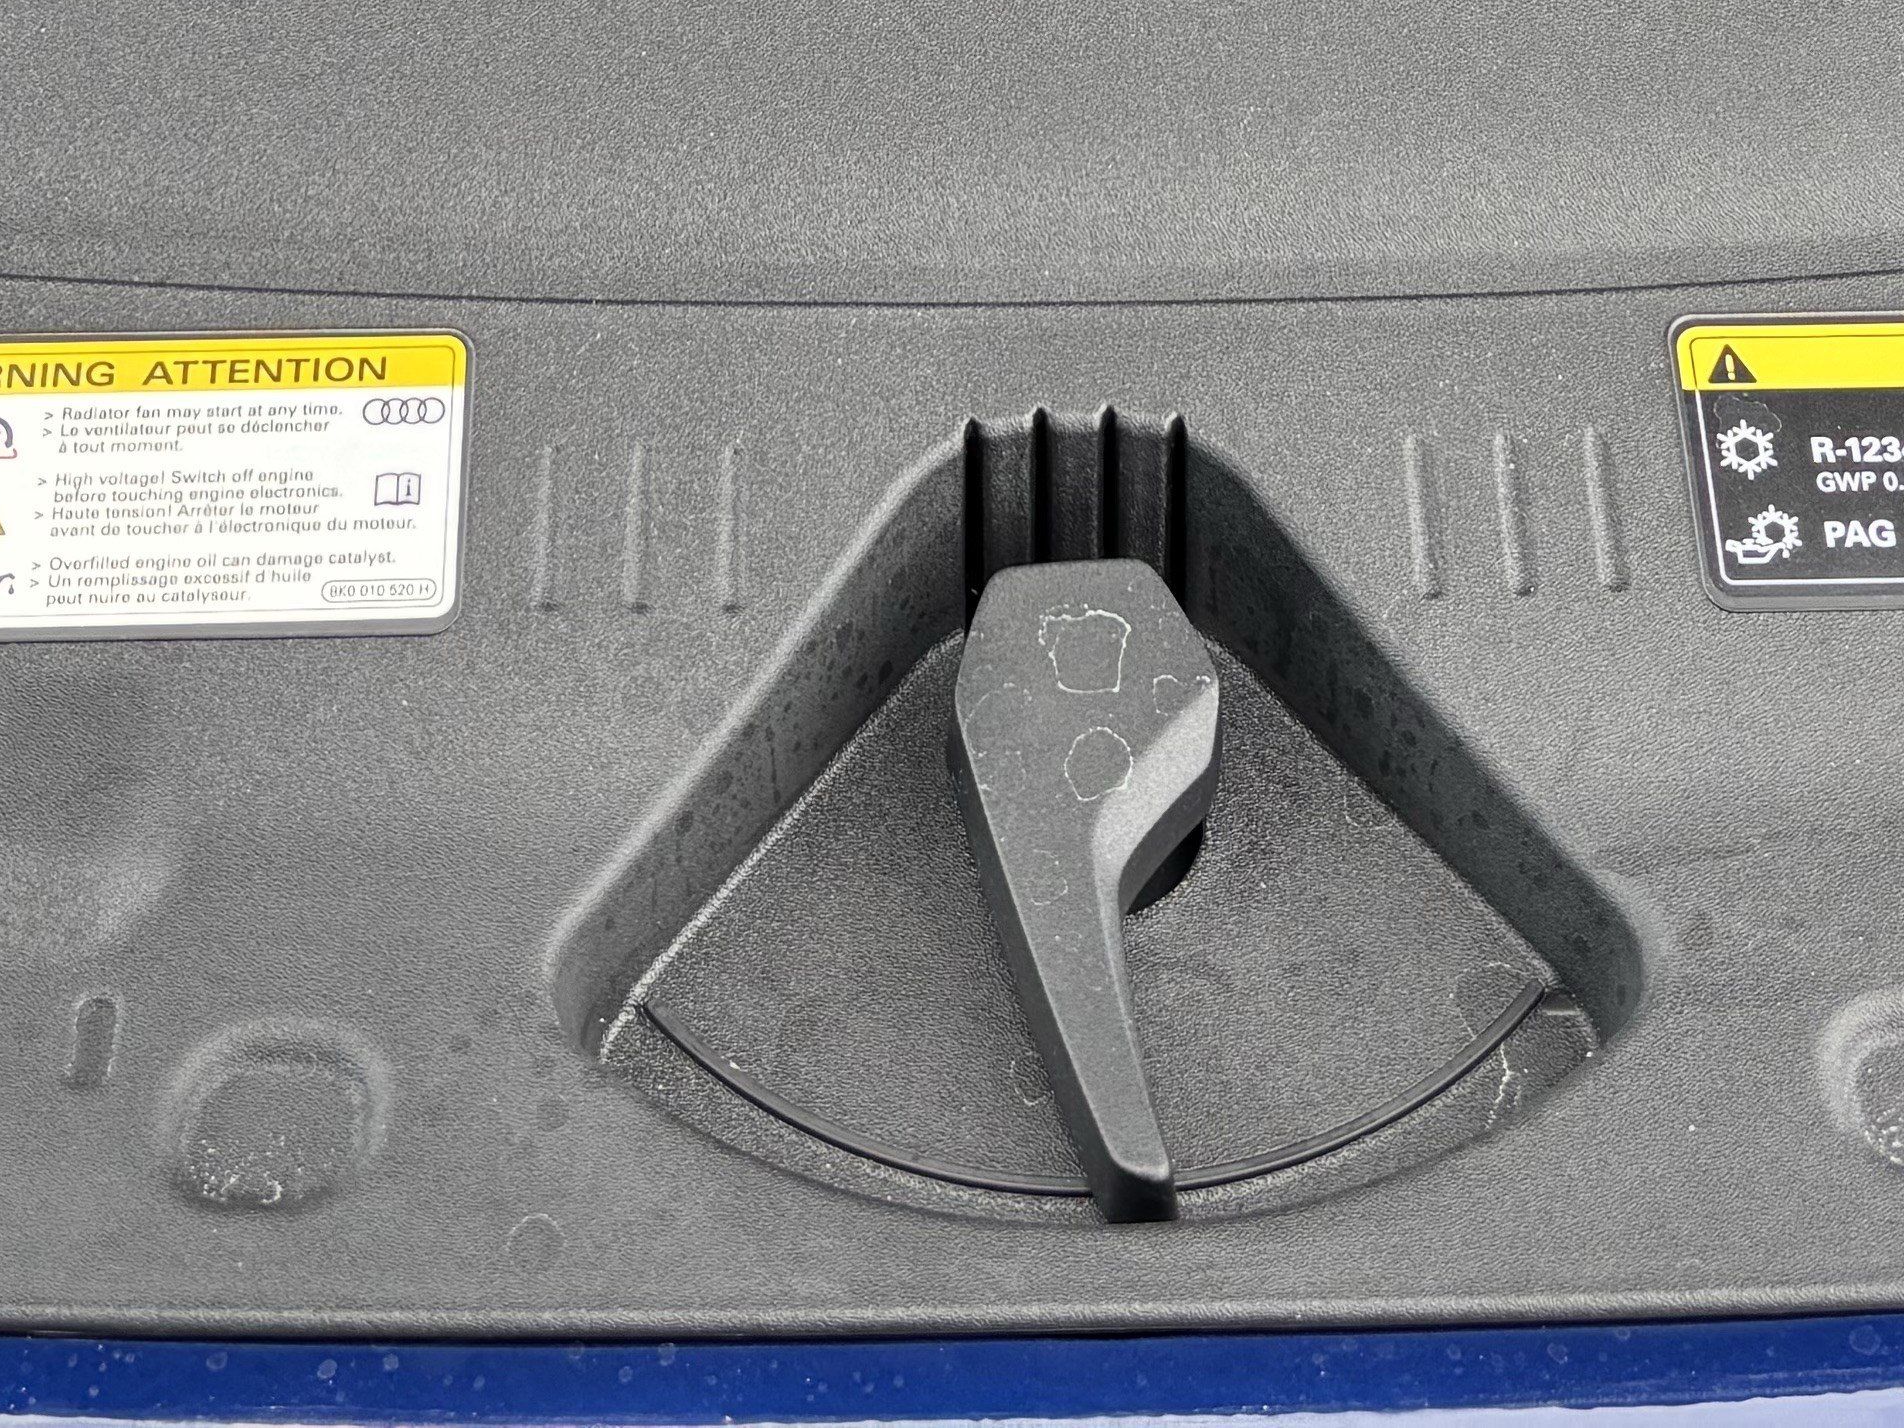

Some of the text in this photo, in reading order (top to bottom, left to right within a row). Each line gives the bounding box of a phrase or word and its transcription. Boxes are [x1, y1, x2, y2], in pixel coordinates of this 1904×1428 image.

[142, 356, 387, 385] ATTENTION
[62, 403, 343, 423] Radiator fan may start at any time.
[60, 419, 330, 437] Le ventilateur peut se déclencher
[73, 441, 105, 454] tout
[111, 439, 183, 453] moment.
[55, 468, 313, 489] High voltage! Switch off engine
[1816, 472, 1877, 492] GWP
[54, 484, 343, 505] before touching engine electronics.
[51, 505, 99, 520] Haute
[106, 504, 172, 519] tension!
[240, 502, 254, 516] le
[259, 502, 319, 515] moteur
[50, 522, 95, 537] avant
[101, 521, 120, 536] de
[127, 520, 189, 535] toucher
[327, 517, 347, 531] du
[352, 516, 416, 530] moteur.
[1824, 519, 1897, 547] PAG
[50, 550, 396, 572] Overfilled engine oil can damage catalyst.
[48, 573, 72, 588] Un
[77, 571, 178, 589] remplissage
[184, 568, 250, 585] excessif
[46, 589, 83, 607] peut
[89, 589, 130, 605] nuire
[137, 591, 155, 604] au
[360, 584, 385, 597] 010
